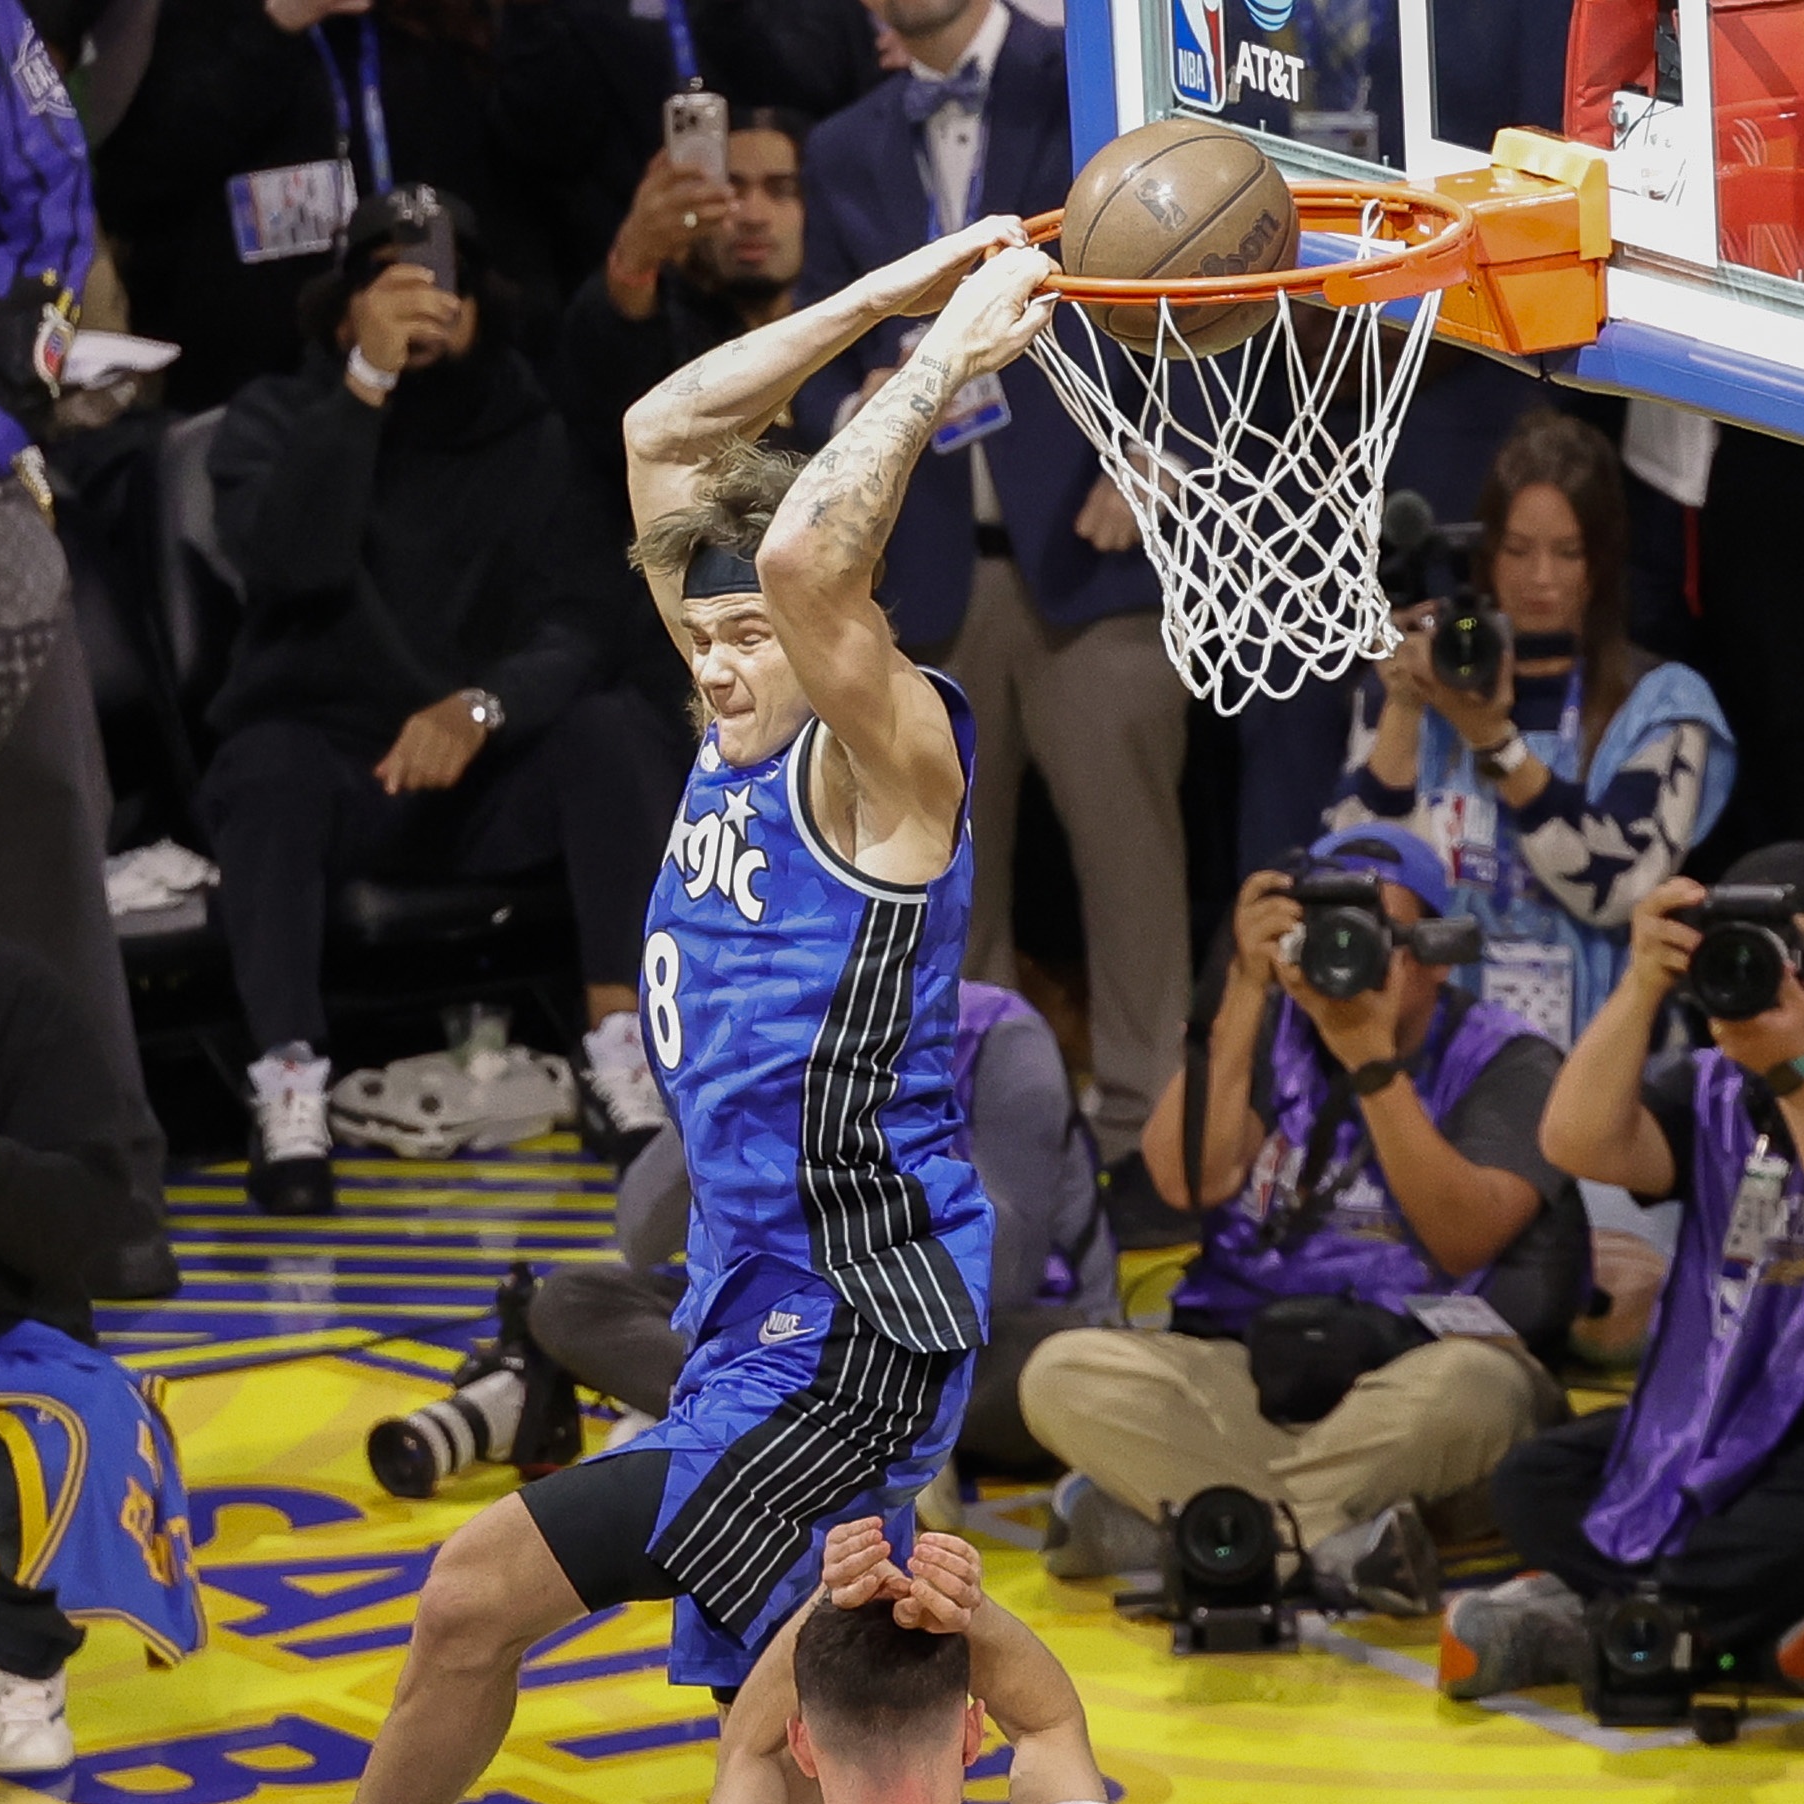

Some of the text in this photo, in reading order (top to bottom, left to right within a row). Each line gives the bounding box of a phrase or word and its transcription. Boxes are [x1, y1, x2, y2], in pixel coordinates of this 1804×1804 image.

[1177, 47, 1206, 93] NBA
[1234, 40, 1305, 103] AT&T
[645, 929, 683, 1071] 8
